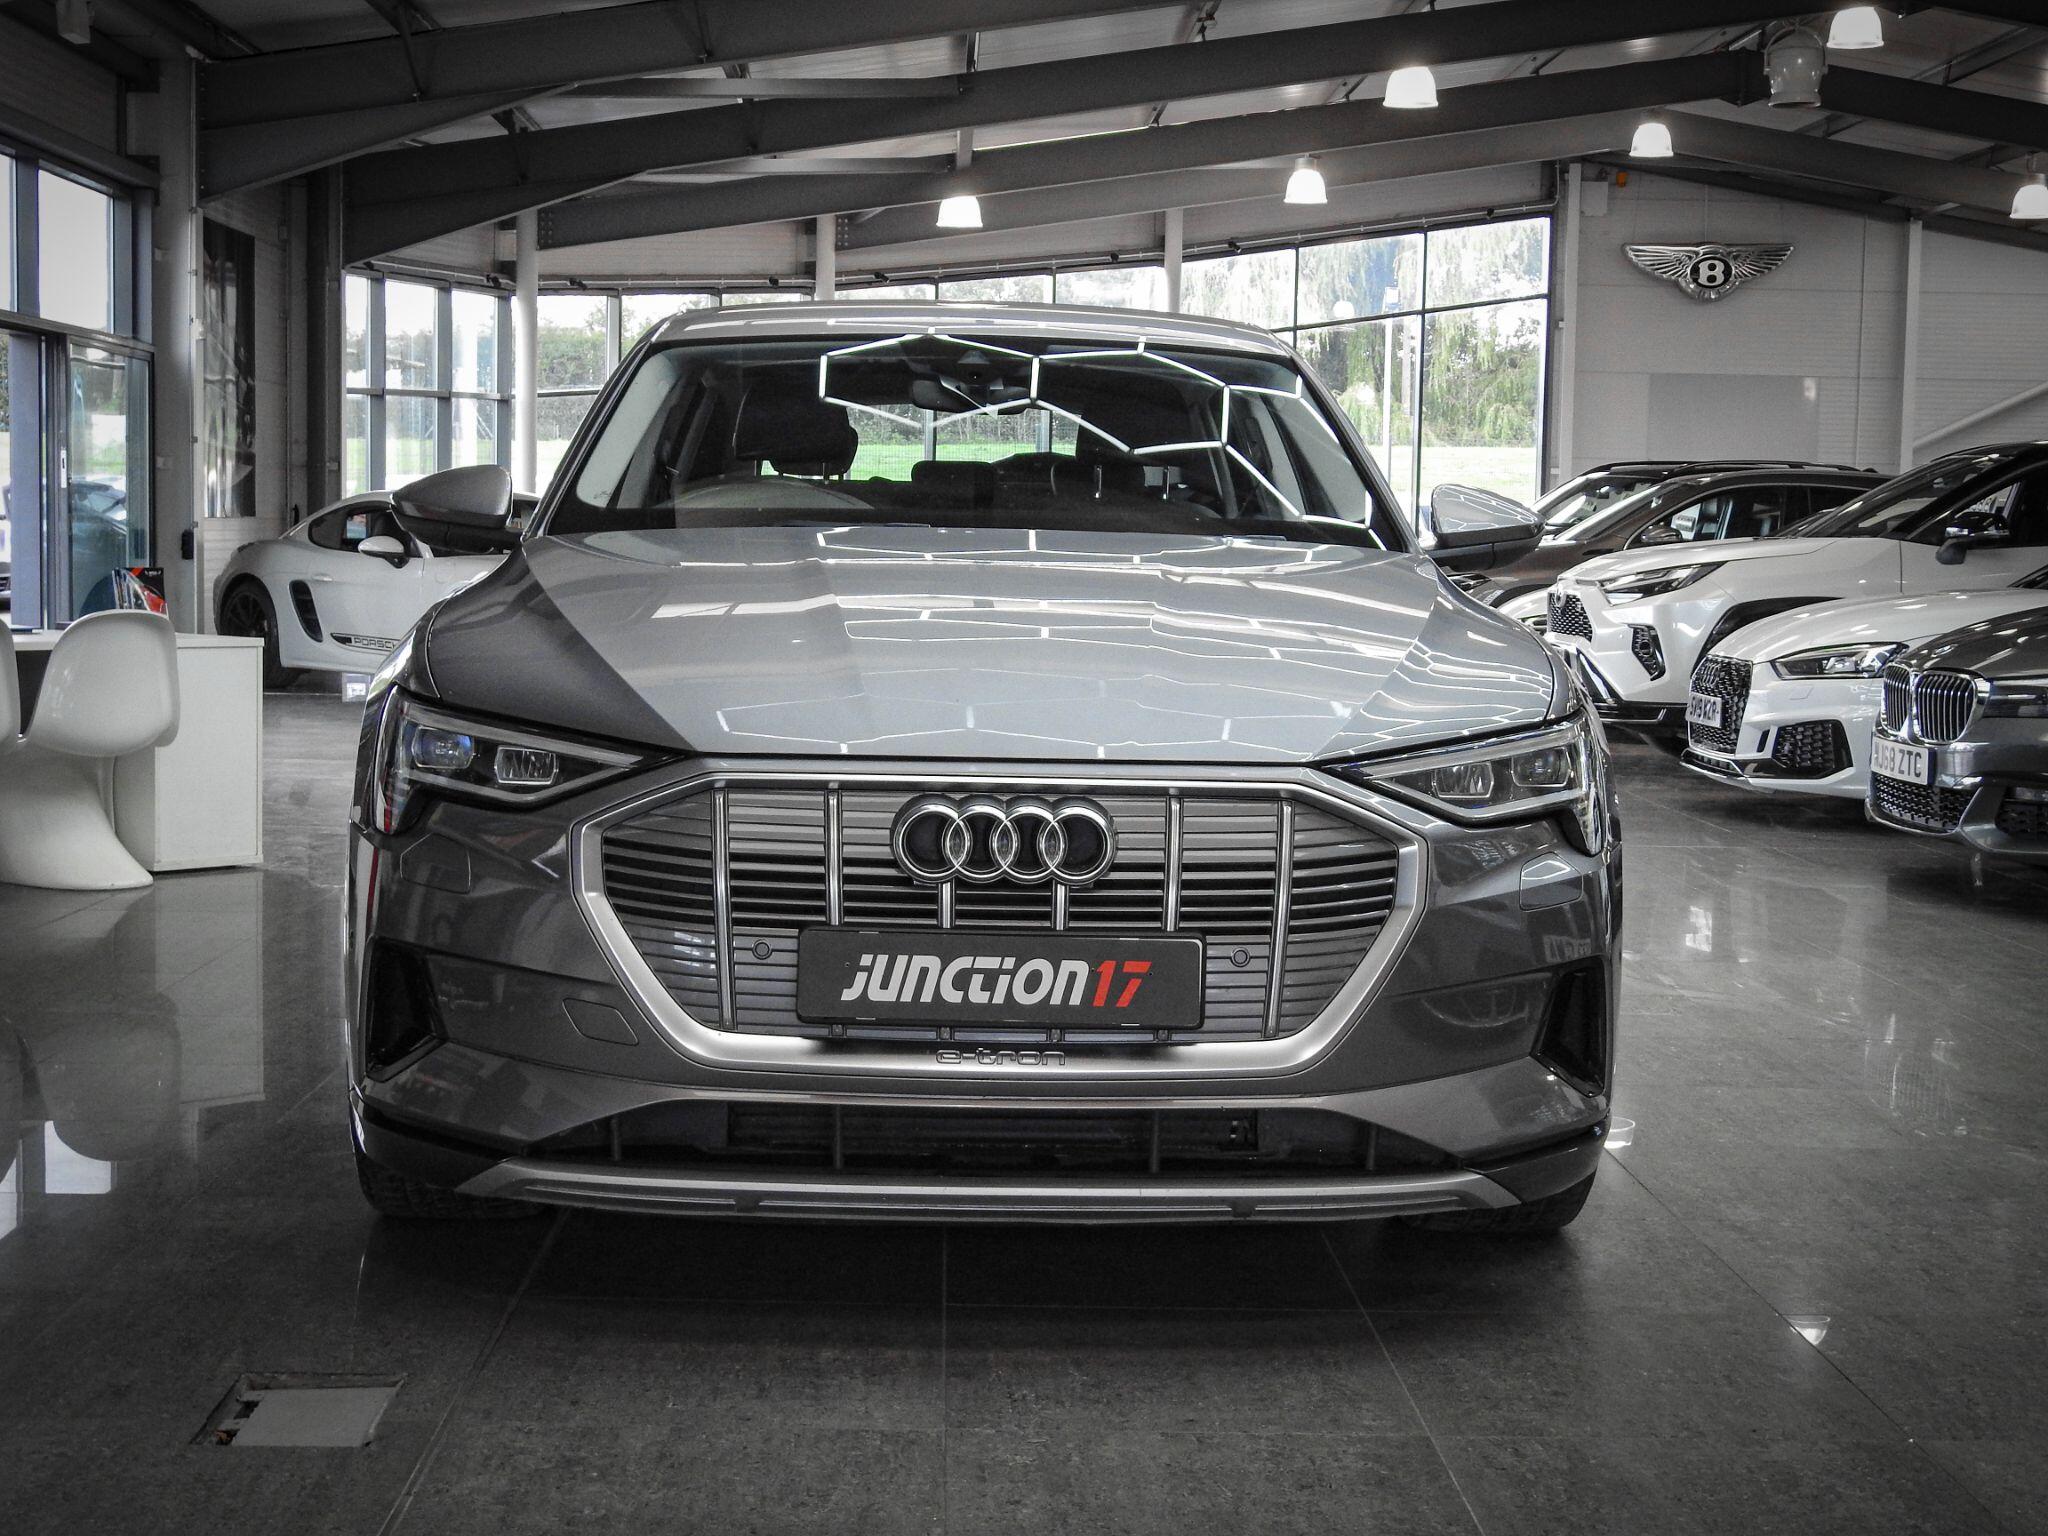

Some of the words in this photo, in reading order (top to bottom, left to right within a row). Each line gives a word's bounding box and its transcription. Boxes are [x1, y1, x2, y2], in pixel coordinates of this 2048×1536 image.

[1698, 259, 1725, 286] B
[1898, 749, 1922, 778] ZTC
[936, 1047, 1066, 1066] e-tron
